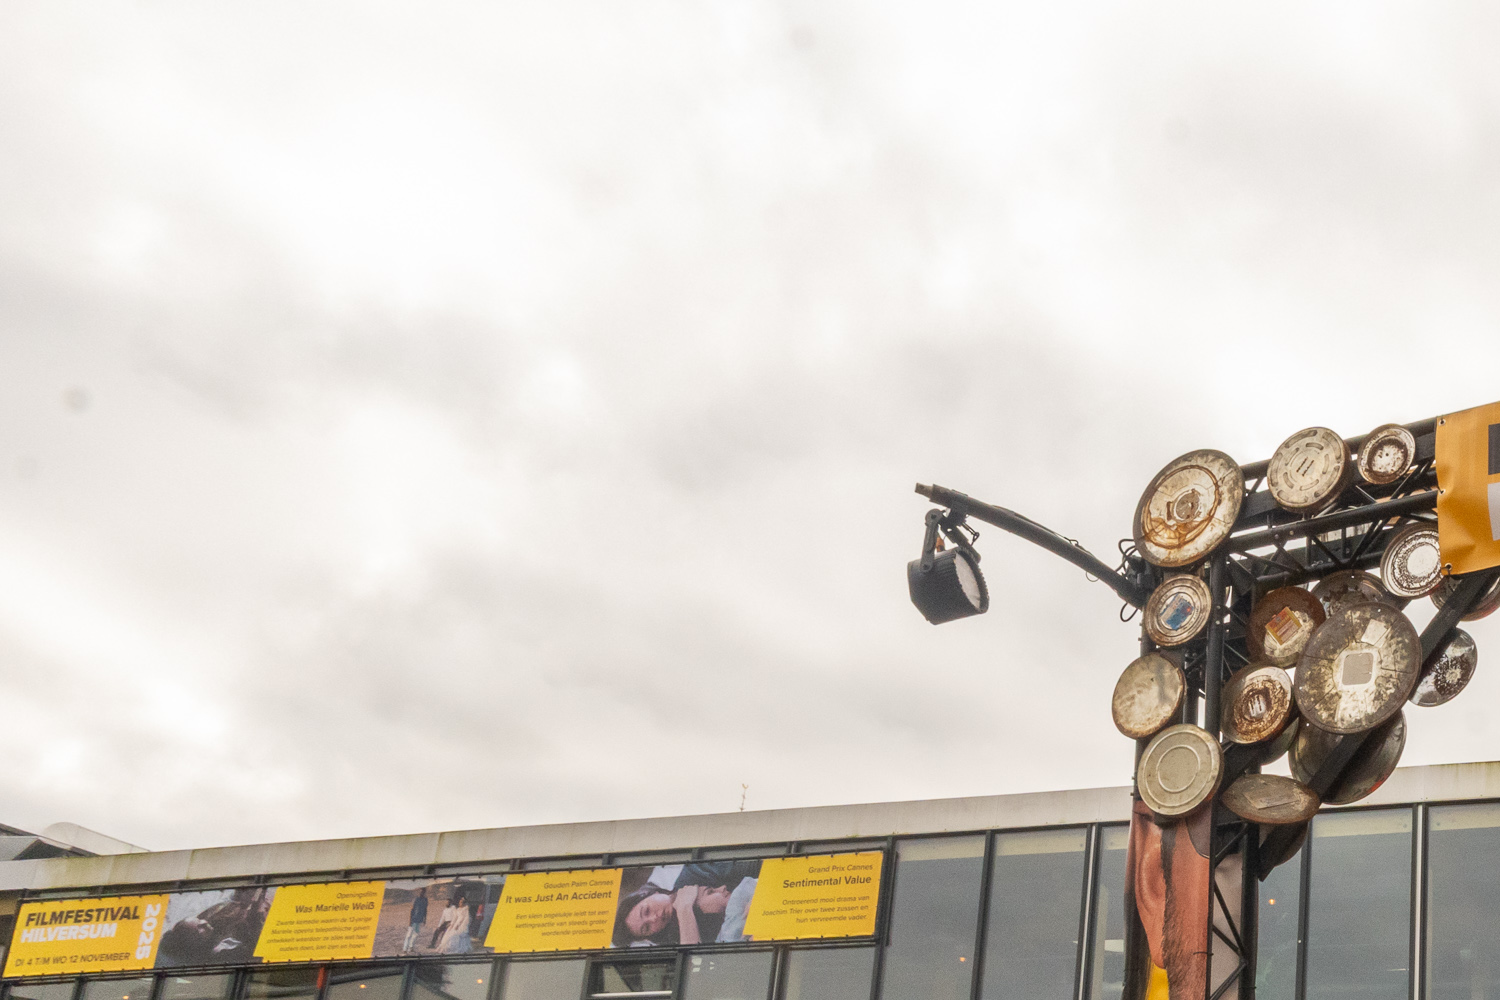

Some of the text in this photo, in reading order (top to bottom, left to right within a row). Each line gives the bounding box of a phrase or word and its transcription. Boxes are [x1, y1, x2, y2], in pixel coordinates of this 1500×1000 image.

[783, 875, 871, 888] Sentimental Value
[534, 894, 553, 902] Just
[571, 890, 612, 900] Accident
[295, 902, 375, 913] Was Marielle Weiß
[25, 906, 140, 926] FILMFESTIVAL
[21, 923, 118, 943] HILVERSUM
[135, 904, 161, 960] 2025
[80, 952, 130, 962] NOVEMBER
